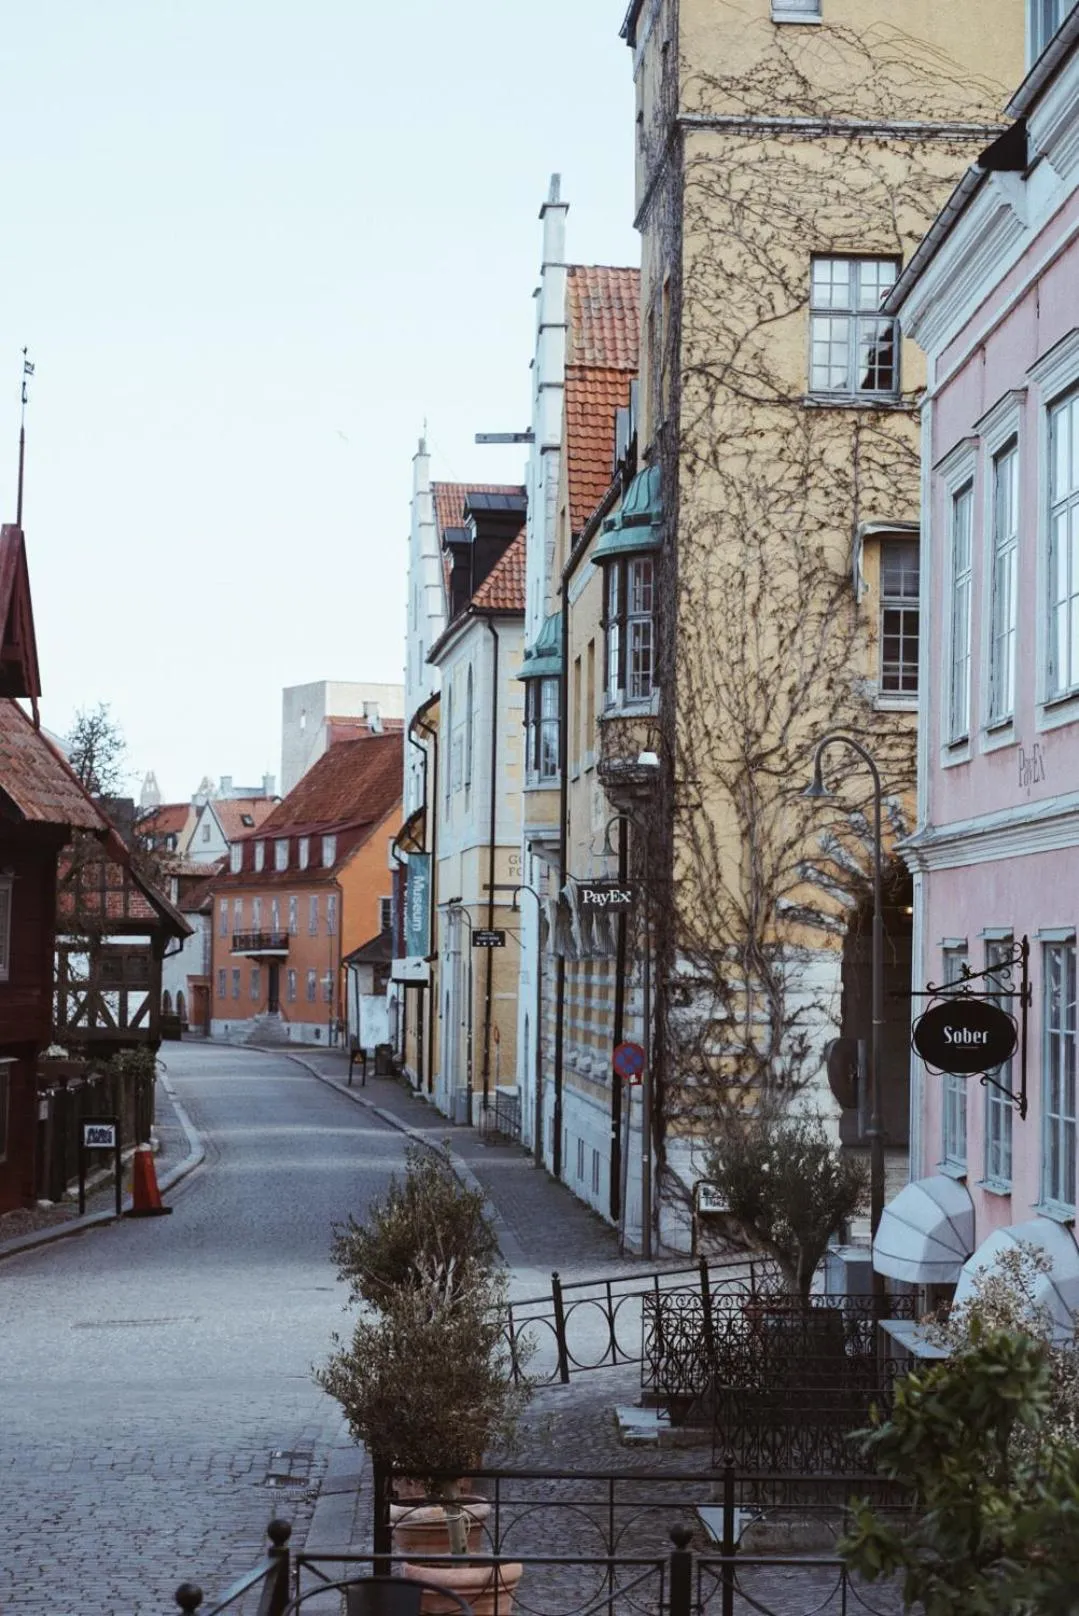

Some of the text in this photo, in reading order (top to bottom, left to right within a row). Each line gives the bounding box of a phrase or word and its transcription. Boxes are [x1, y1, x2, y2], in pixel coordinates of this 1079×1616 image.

[508, 854, 522, 865] G
[412, 875, 425, 932] Museum
[582, 889, 631, 906] PayEx
[943, 1026, 989, 1044] Sober
